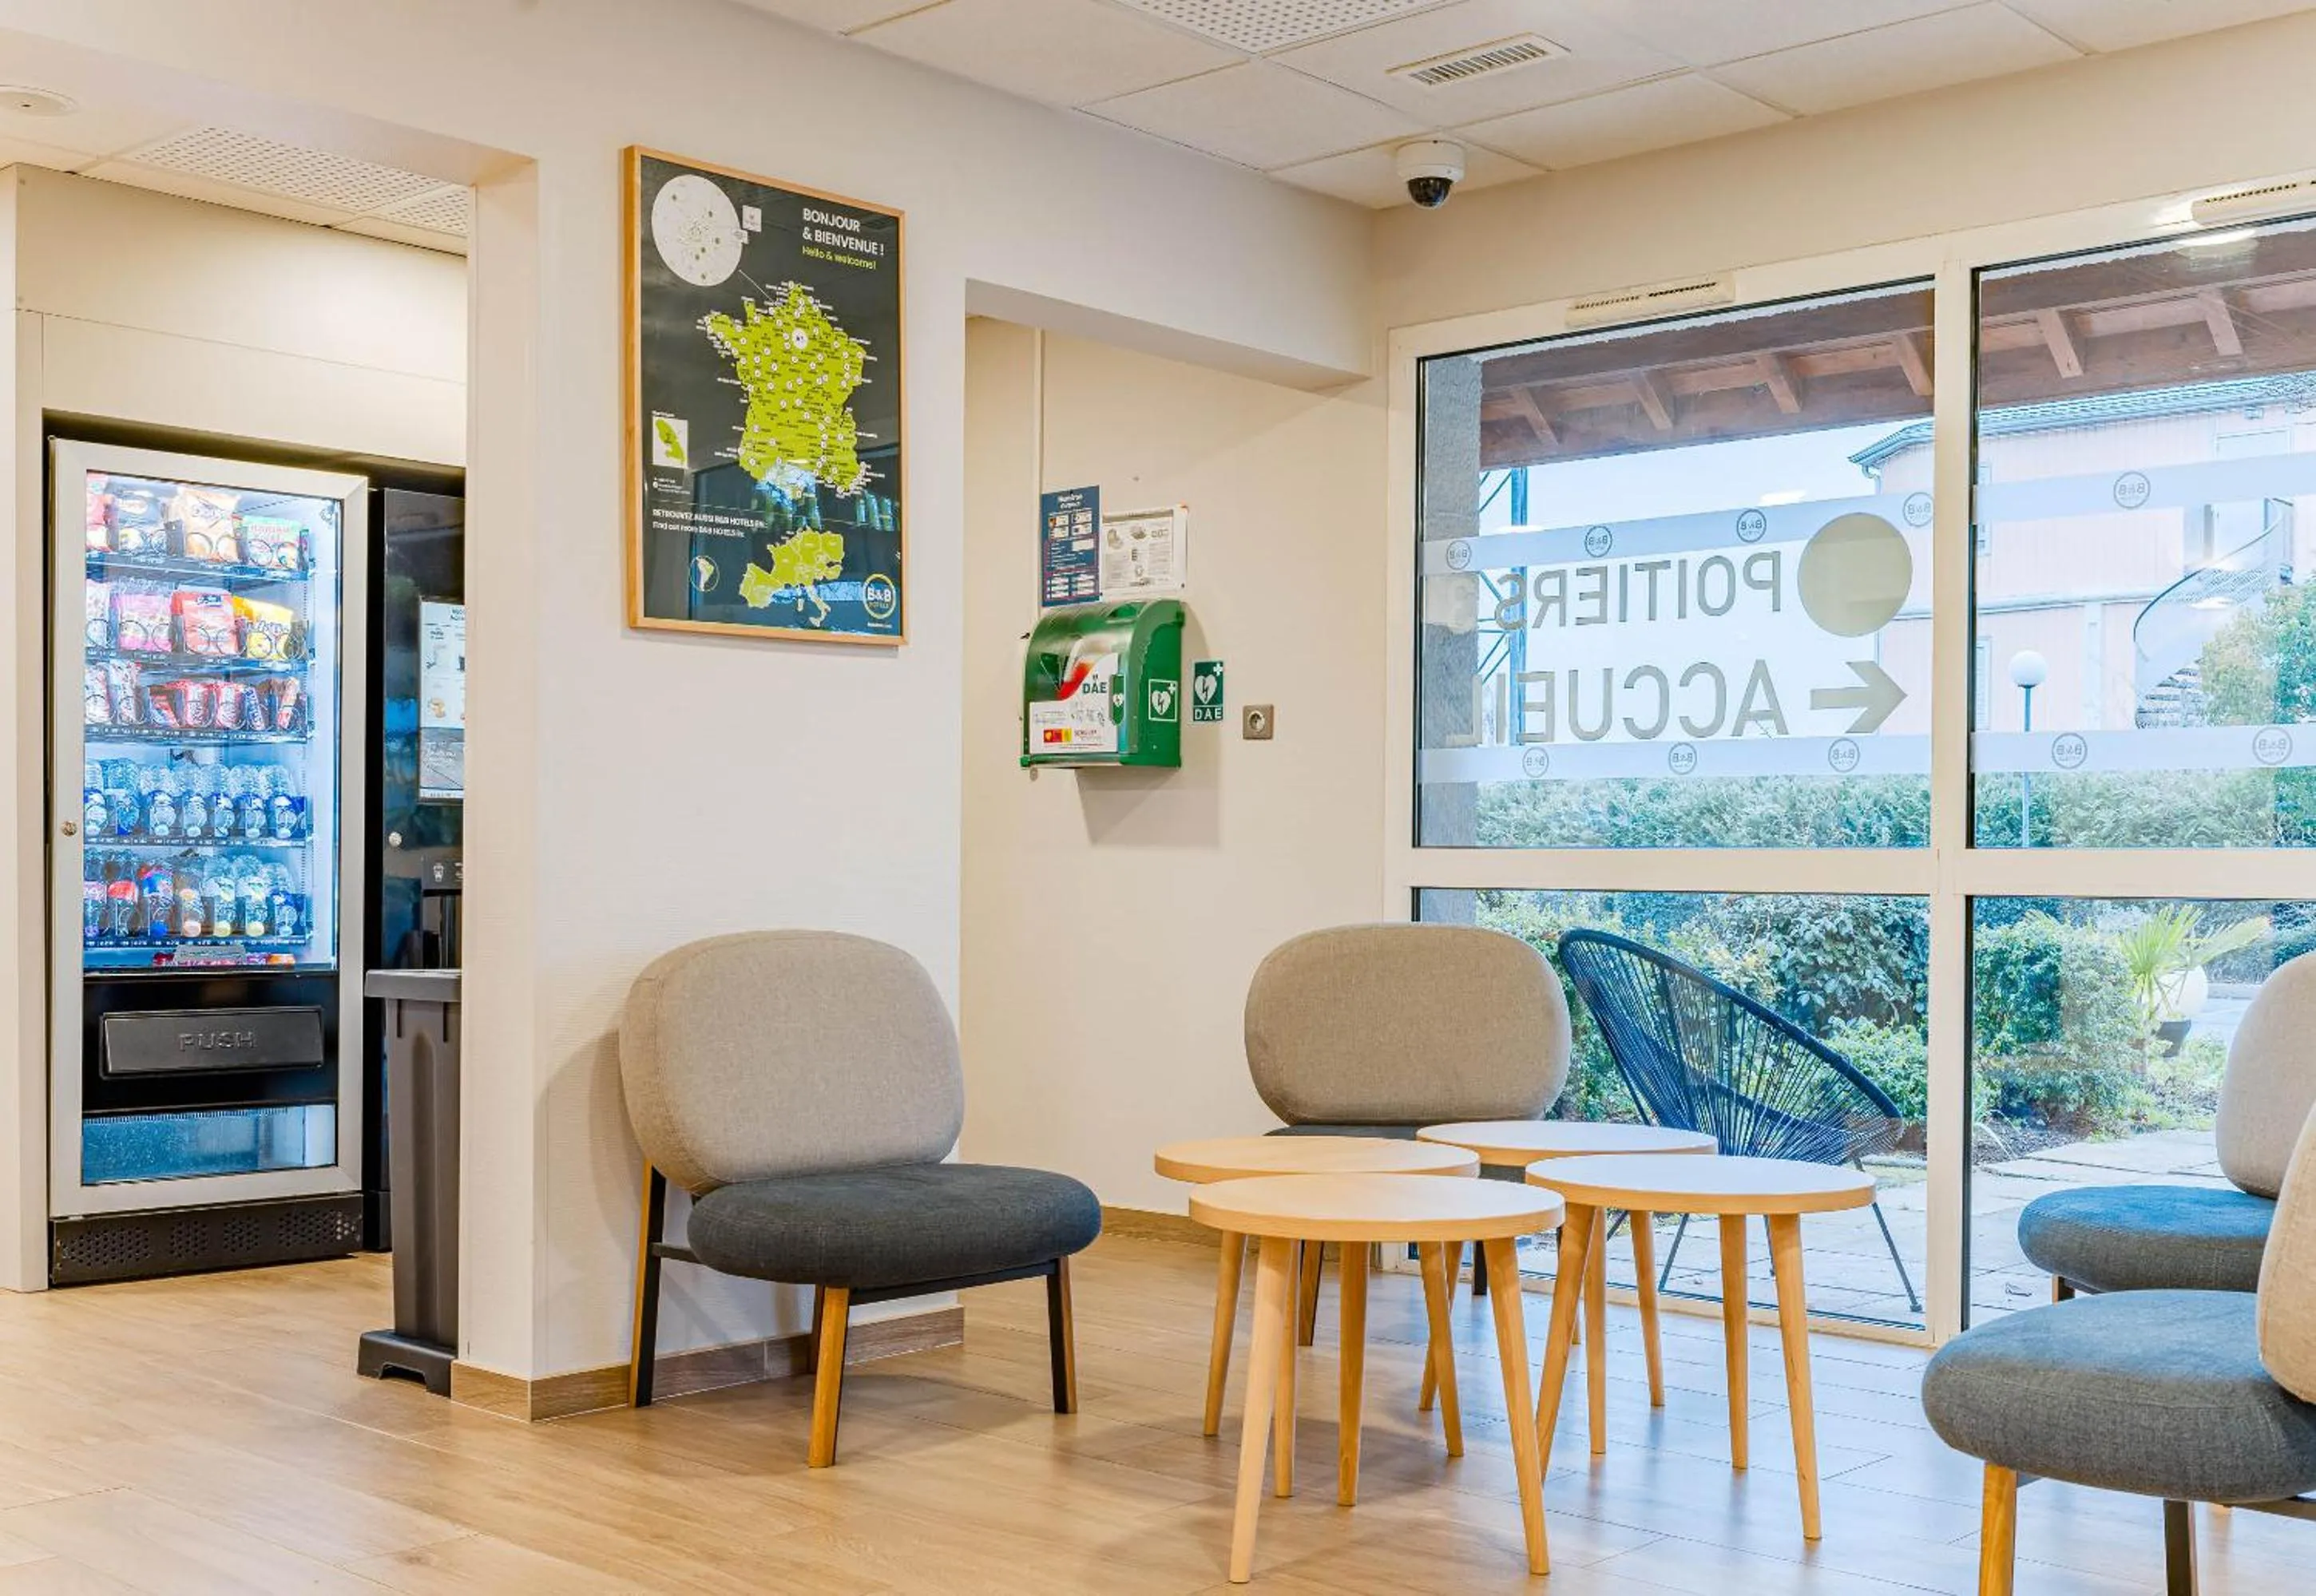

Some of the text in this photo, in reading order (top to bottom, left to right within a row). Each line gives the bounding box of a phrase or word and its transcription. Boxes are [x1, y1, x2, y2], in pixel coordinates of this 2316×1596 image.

[803, 208, 861, 233] BONJOUR
[803, 227, 885, 256] & BIENVENUE !
[802, 245, 825, 259] Hello
[826, 251, 833, 260] &
[867, 587, 891, 602] B&B
[1082, 682, 1108, 694] DAE
[1195, 707, 1223, 720] DAE
[180, 1032, 256, 1052] PUSH
